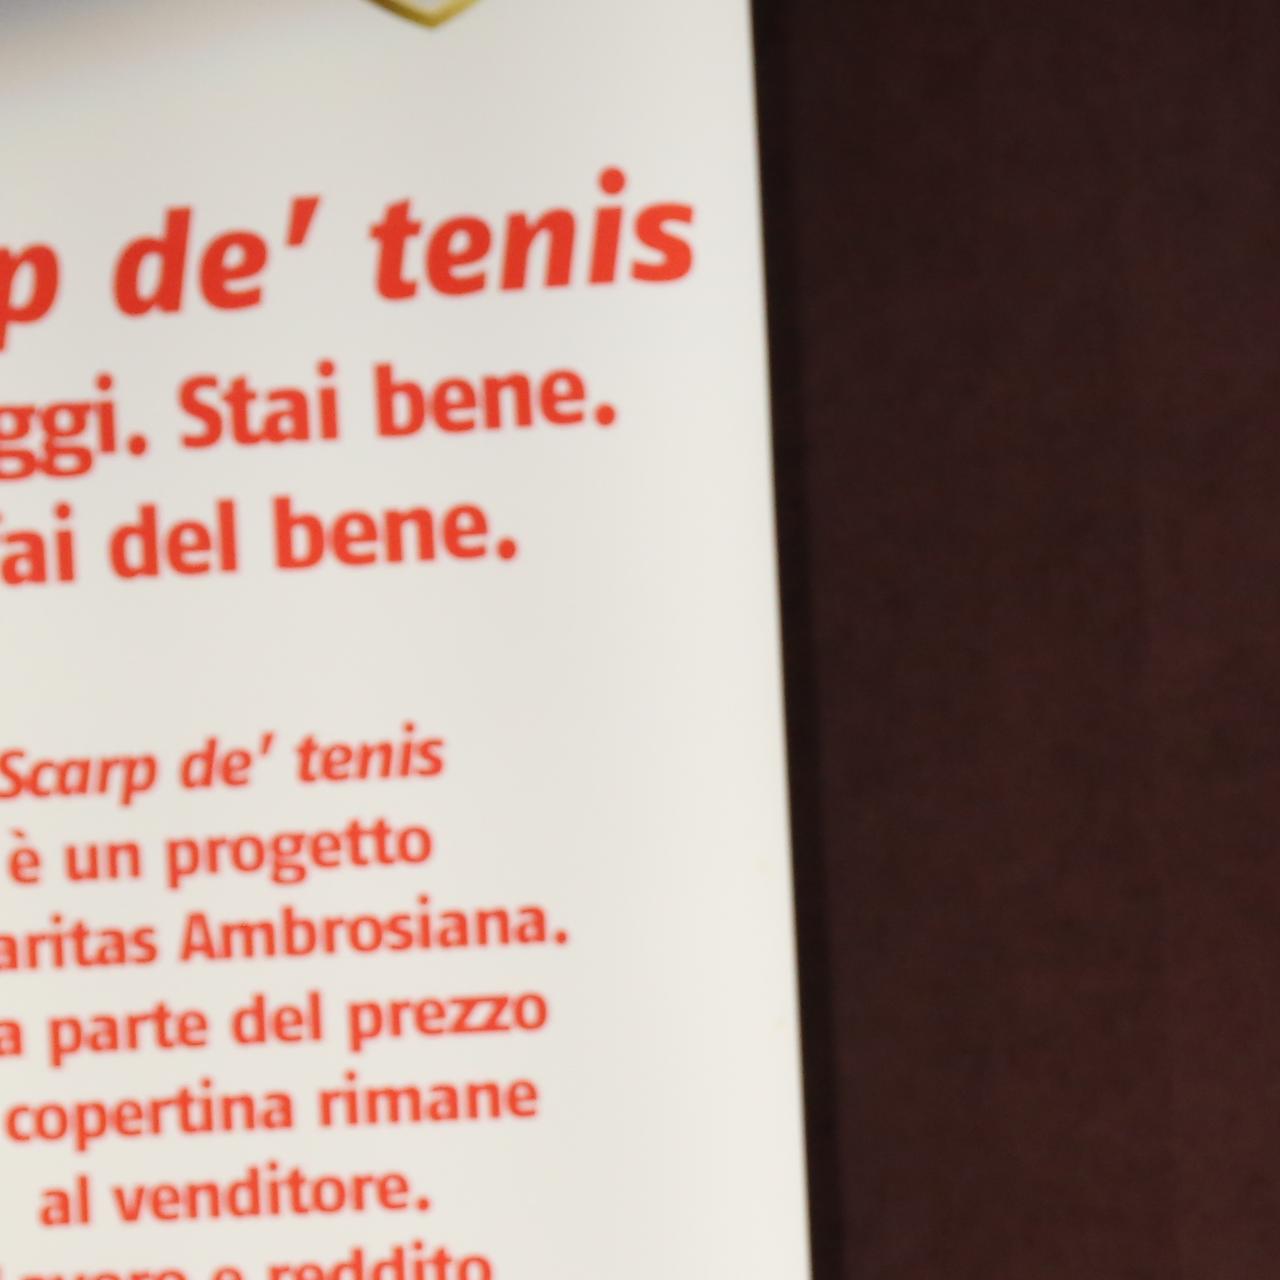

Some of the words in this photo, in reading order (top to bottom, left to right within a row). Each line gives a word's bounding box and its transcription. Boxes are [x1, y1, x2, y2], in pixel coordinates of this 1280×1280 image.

[113, 195, 321, 318] de'
[370, 166, 695, 302] tenis
[178, 359, 340, 450] Stai
[374, 362, 617, 439] bene.
[109, 499, 239, 580] del
[273, 495, 518, 572] bene.
[0, 748, 159, 807] Scarp
[180, 732, 274, 790] de'
[297, 722, 445, 784] tenis
[8, 828, 42, 885] è
[65, 840, 142, 882] un
[166, 818, 434, 891] progetto
[180, 895, 569, 962] Ambrosiana.
[48, 1002, 209, 1069] parte
[231, 991, 324, 1046] del
[348, 992, 549, 1054] prezzo
[4, 1077, 295, 1153] copertina
[318, 1071, 540, 1128] rimane
[39, 1174, 91, 1227] al
[113, 1160, 431, 1223] venditore.
